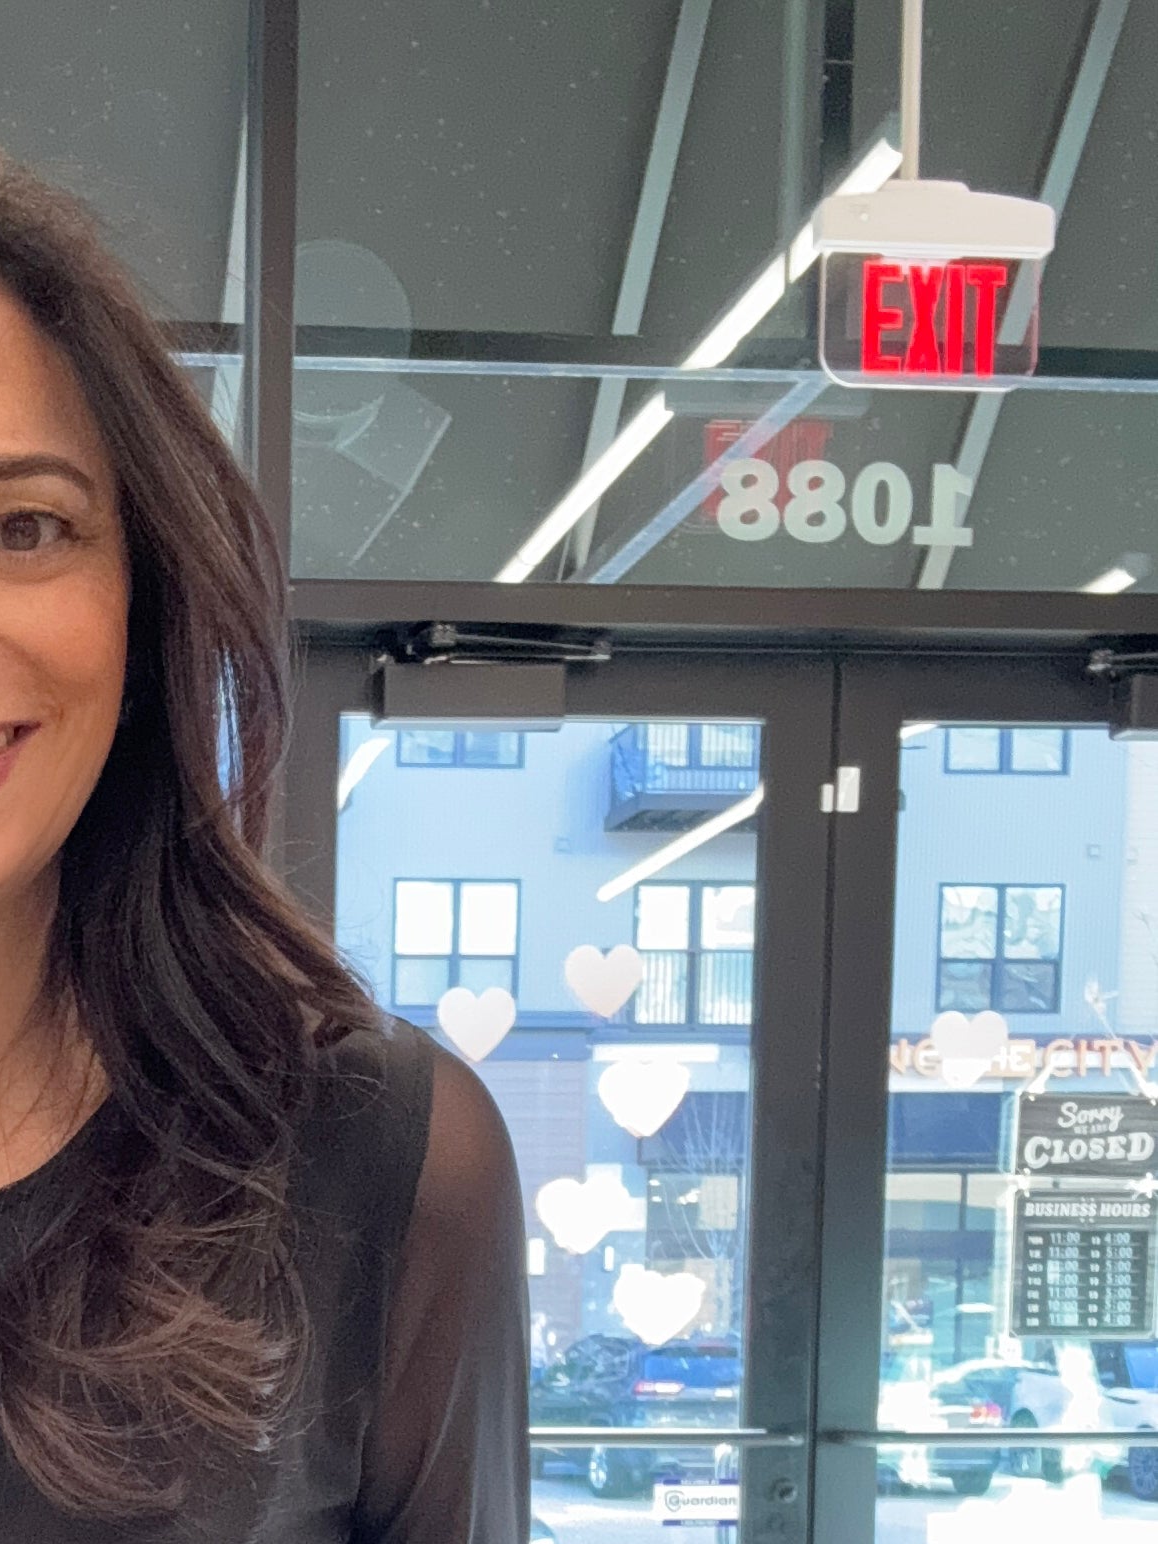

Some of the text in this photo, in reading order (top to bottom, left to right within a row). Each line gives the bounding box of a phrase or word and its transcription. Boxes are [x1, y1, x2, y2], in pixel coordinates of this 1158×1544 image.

[860, 258, 1007, 379] EXIT
[1042, 1039, 1158, 1077] CITY
[1058, 1101, 1125, 1132] Sorry
[1024, 1132, 1155, 1169] CLOSED
[1024, 1202, 1152, 1217] BUSINESS HOURS
[665, 1490, 738, 1512] Guardian
